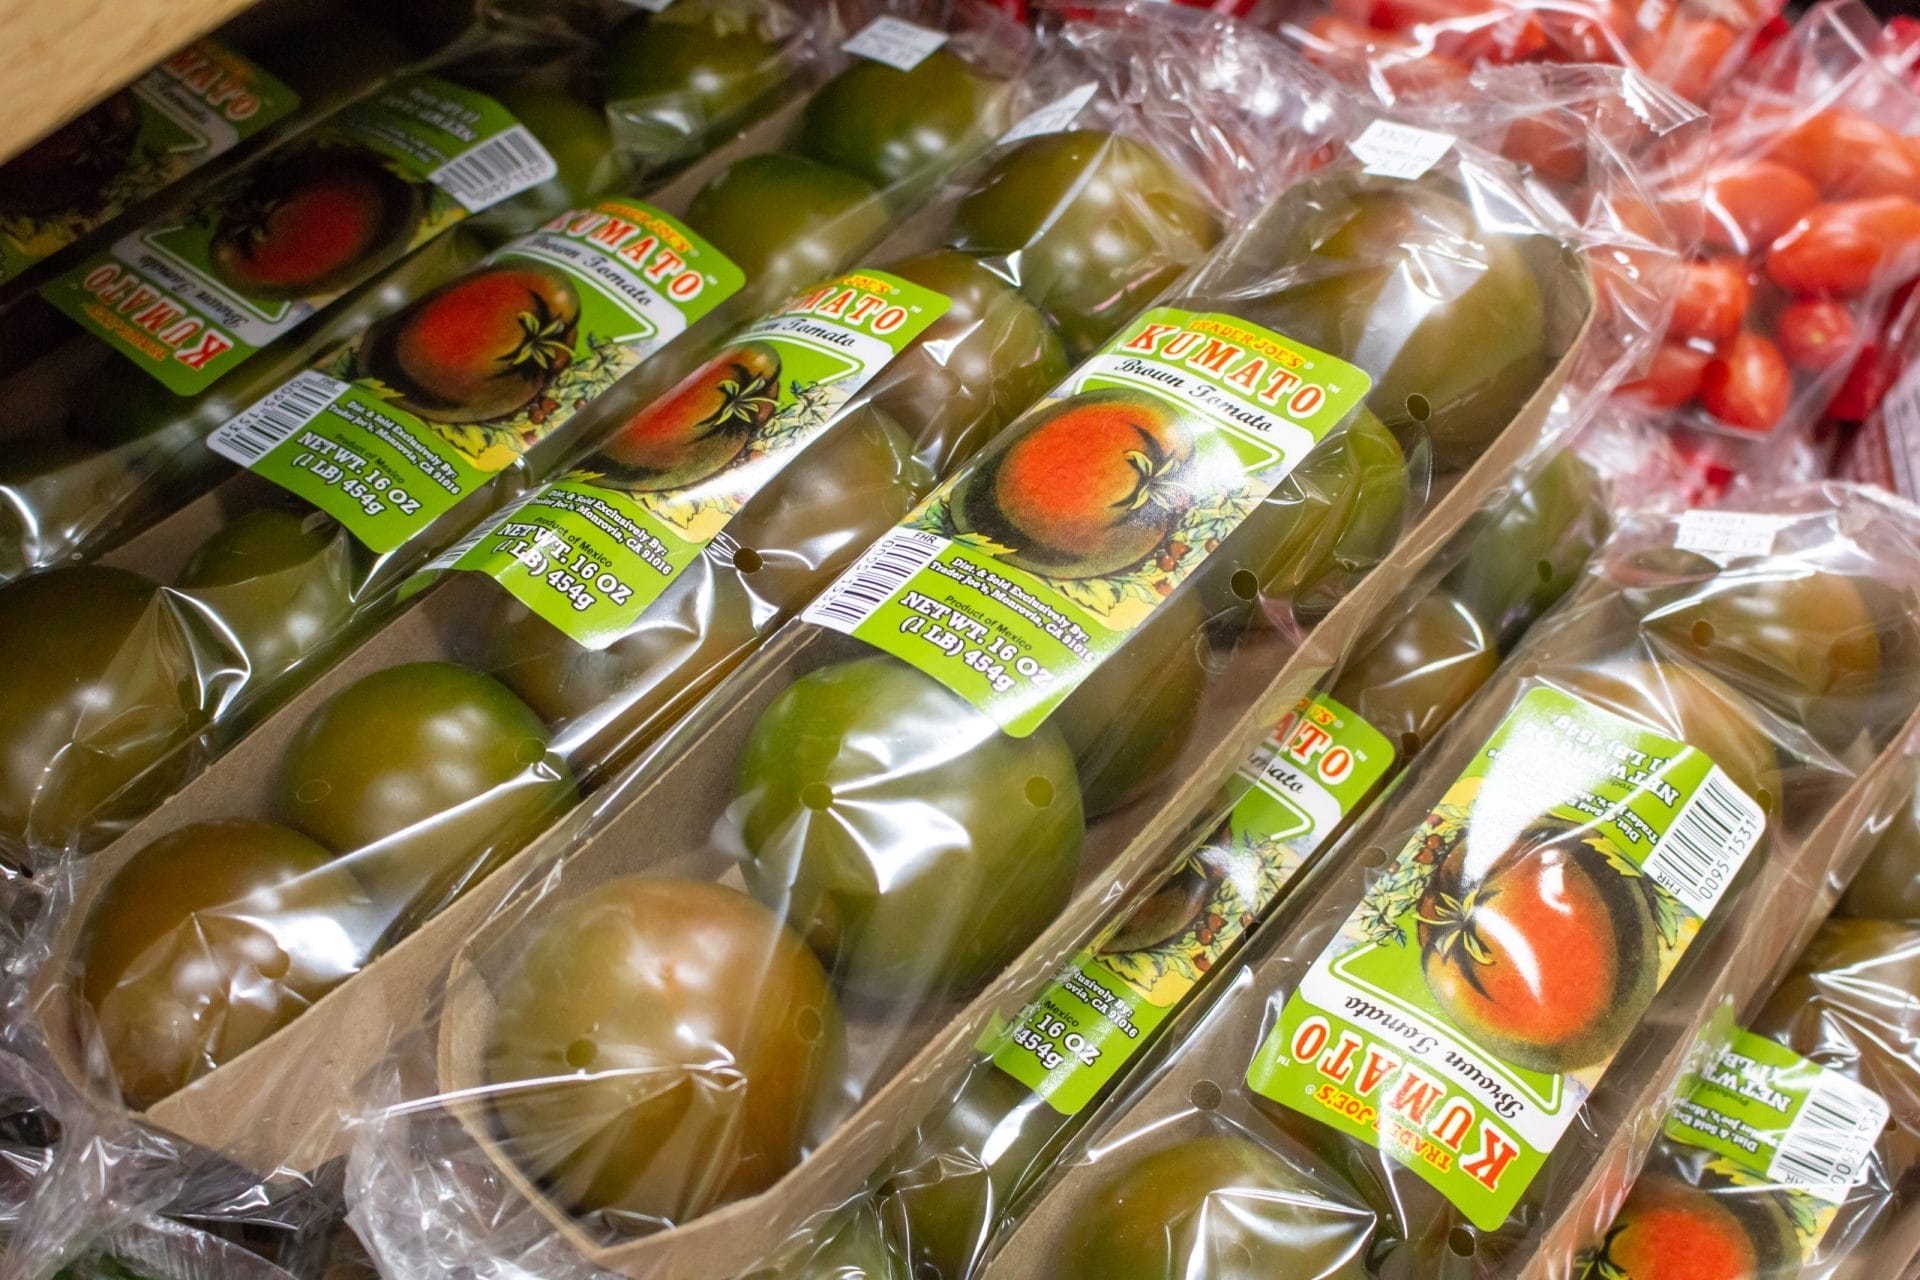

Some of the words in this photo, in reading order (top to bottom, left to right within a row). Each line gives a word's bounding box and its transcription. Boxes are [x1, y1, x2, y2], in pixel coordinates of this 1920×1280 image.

[583, 255, 652, 306] Tomato
[83, 264, 235, 371] KUMATO
[782, 318, 856, 347] Tomato
[1189, 320, 1256, 345] TRADER
[1253, 338, 1306, 369] JOE'S
[1114, 359, 1184, 389] Brown
[1188, 384, 1273, 433] Tomato
[1121, 323, 1325, 419] KUMATO
[393, 422, 442, 467] Exclusively
[297, 432, 337, 454] NET
[333, 446, 368, 474] WT.
[365, 468, 391, 491] 16
[387, 488, 422, 516] OZ
[310, 460, 344, 485] LB)
[342, 479, 386, 516] 454g
[419, 461, 434, 477] CA
[431, 470, 461, 495] 91016
[567, 533, 580, 546] of
[579, 540, 613, 569] Mexico
[576, 505, 625, 544] Monrovia,
[624, 537, 644, 555] CA
[640, 549, 674, 577] 91016
[594, 497, 651, 543] Exclusively
[648, 537, 669, 557] By:
[496, 522, 539, 539] NET
[533, 526, 573, 565] WT.
[569, 554, 601, 581] 16
[595, 572, 634, 607] OZ
[508, 540, 549, 577] LB)
[547, 568, 596, 612] 454g
[951, 557, 977, 576] Dist.
[976, 568, 988, 579] &
[986, 571, 1011, 590] Sold
[1009, 582, 1071, 628] Exclusively
[929, 560, 965, 582] Trader
[990, 587, 1044, 628] Monrovia,
[1044, 621, 1067, 642] CA
[944, 595, 985, 619] Product
[984, 616, 997, 628] of
[995, 624, 1032, 651] Mexico
[898, 590, 953, 620] NET
[946, 609, 990, 644] WT.
[986, 637, 1018, 662] 16
[1015, 656, 1055, 688] OZ
[899, 615, 927, 635] (1
[921, 625, 965, 657] LB)
[964, 649, 1016, 692] 454g
[1656, 871, 1682, 896] FHR
[1042, 1000, 1079, 1027] Mexico
[1091, 997, 1109, 1015] CA
[1106, 1008, 1139, 1039] 91016
[1113, 996, 1134, 1018] By:
[1344, 995, 1439, 1055] Tomato
[1013, 1027, 1065, 1070] 454g
[1036, 1014, 1066, 1038] 16
[1064, 1031, 1102, 1067] OZ
[1291, 1015, 1519, 1193] KUMATO
[1314, 1083, 1374, 1126] JOE'S
[1444, 1051, 1524, 1119] Brown
[1738, 1081, 1793, 1113] NET
